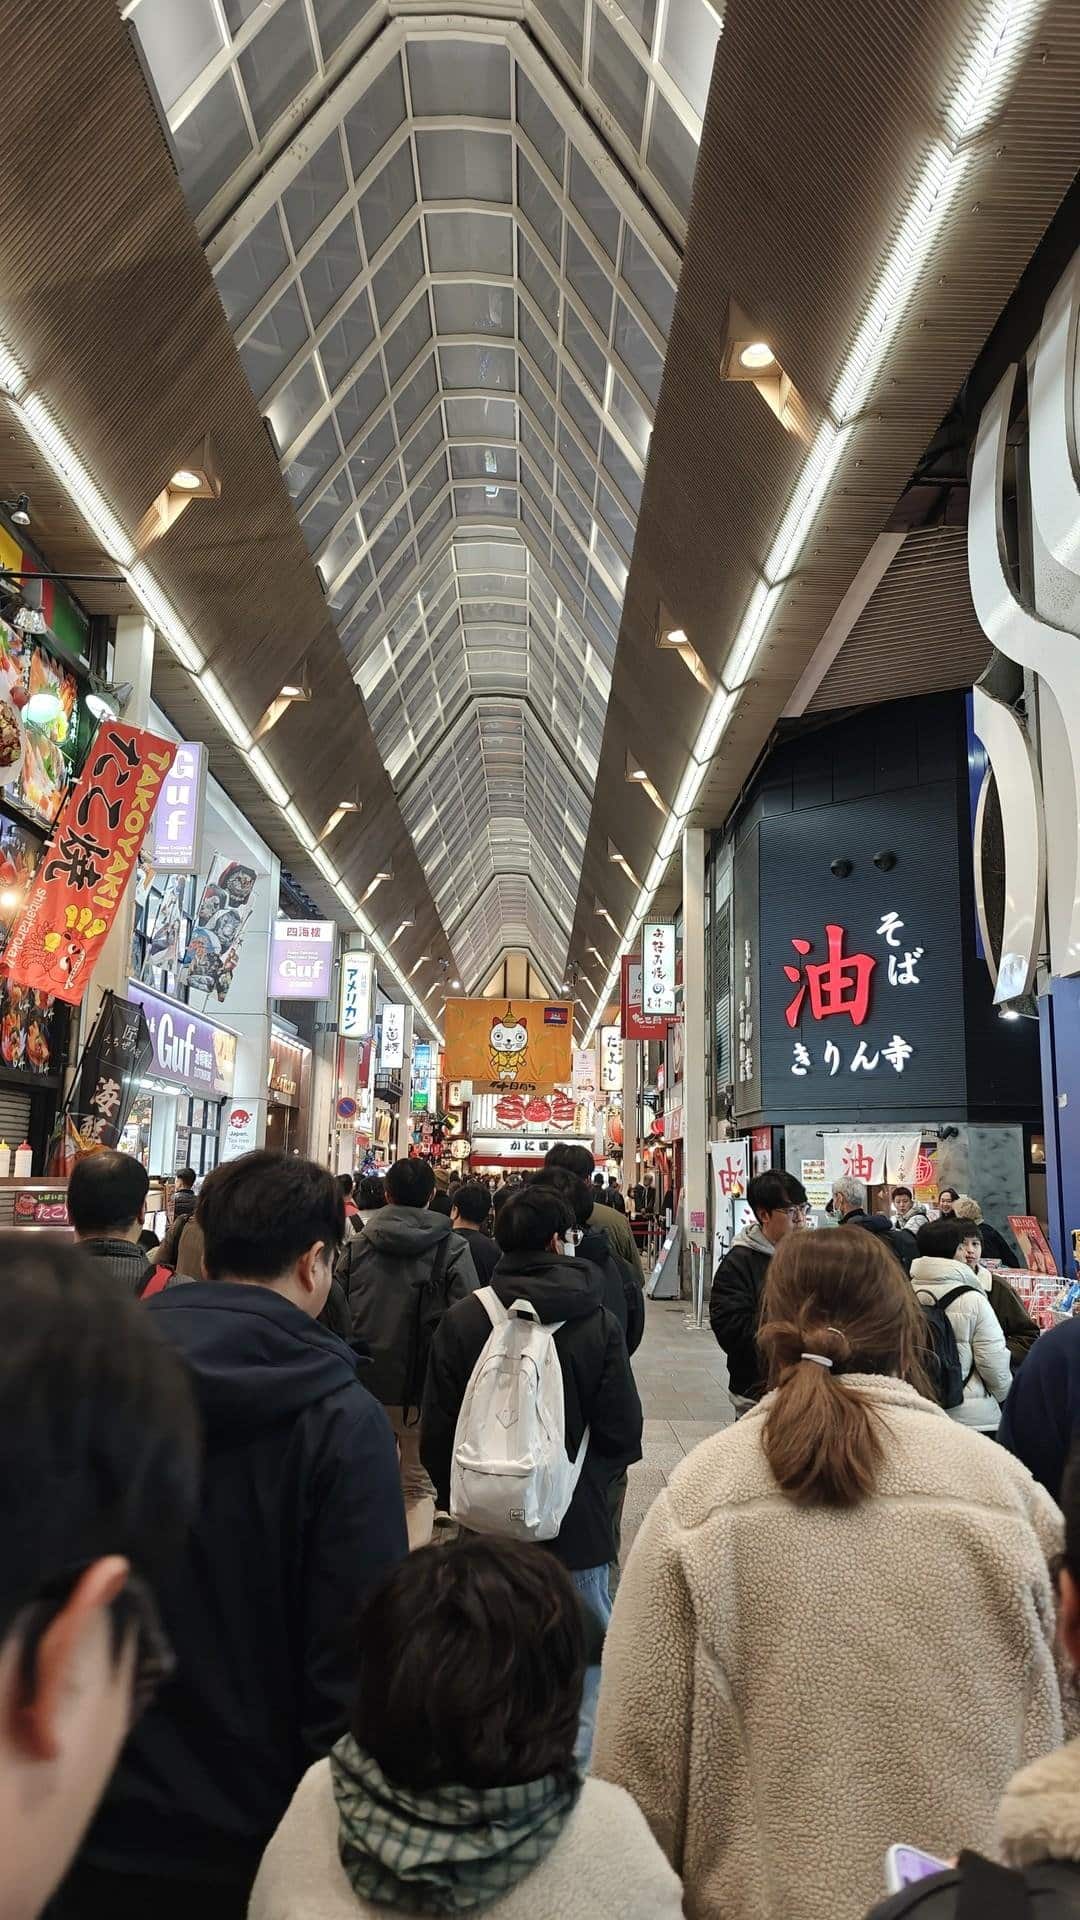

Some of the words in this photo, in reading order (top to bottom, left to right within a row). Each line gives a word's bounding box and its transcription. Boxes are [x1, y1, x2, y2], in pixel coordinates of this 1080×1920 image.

[44, 731, 142, 891] たこ焼
[165, 750, 194, 841] Guf
[93, 751, 170, 909] TAKOYAKI
[278, 960, 324, 979] Guf
[783, 923, 877, 1028] 油
[876, 911, 924, 986] そば
[345, 968, 358, 1031] アメリカン
[157, 1013, 195, 1077] Guf
[791, 1035, 913, 1076] きりん寺
[842, 1144, 874, 1182] 油
[37, 1204, 68, 1220] たこ
